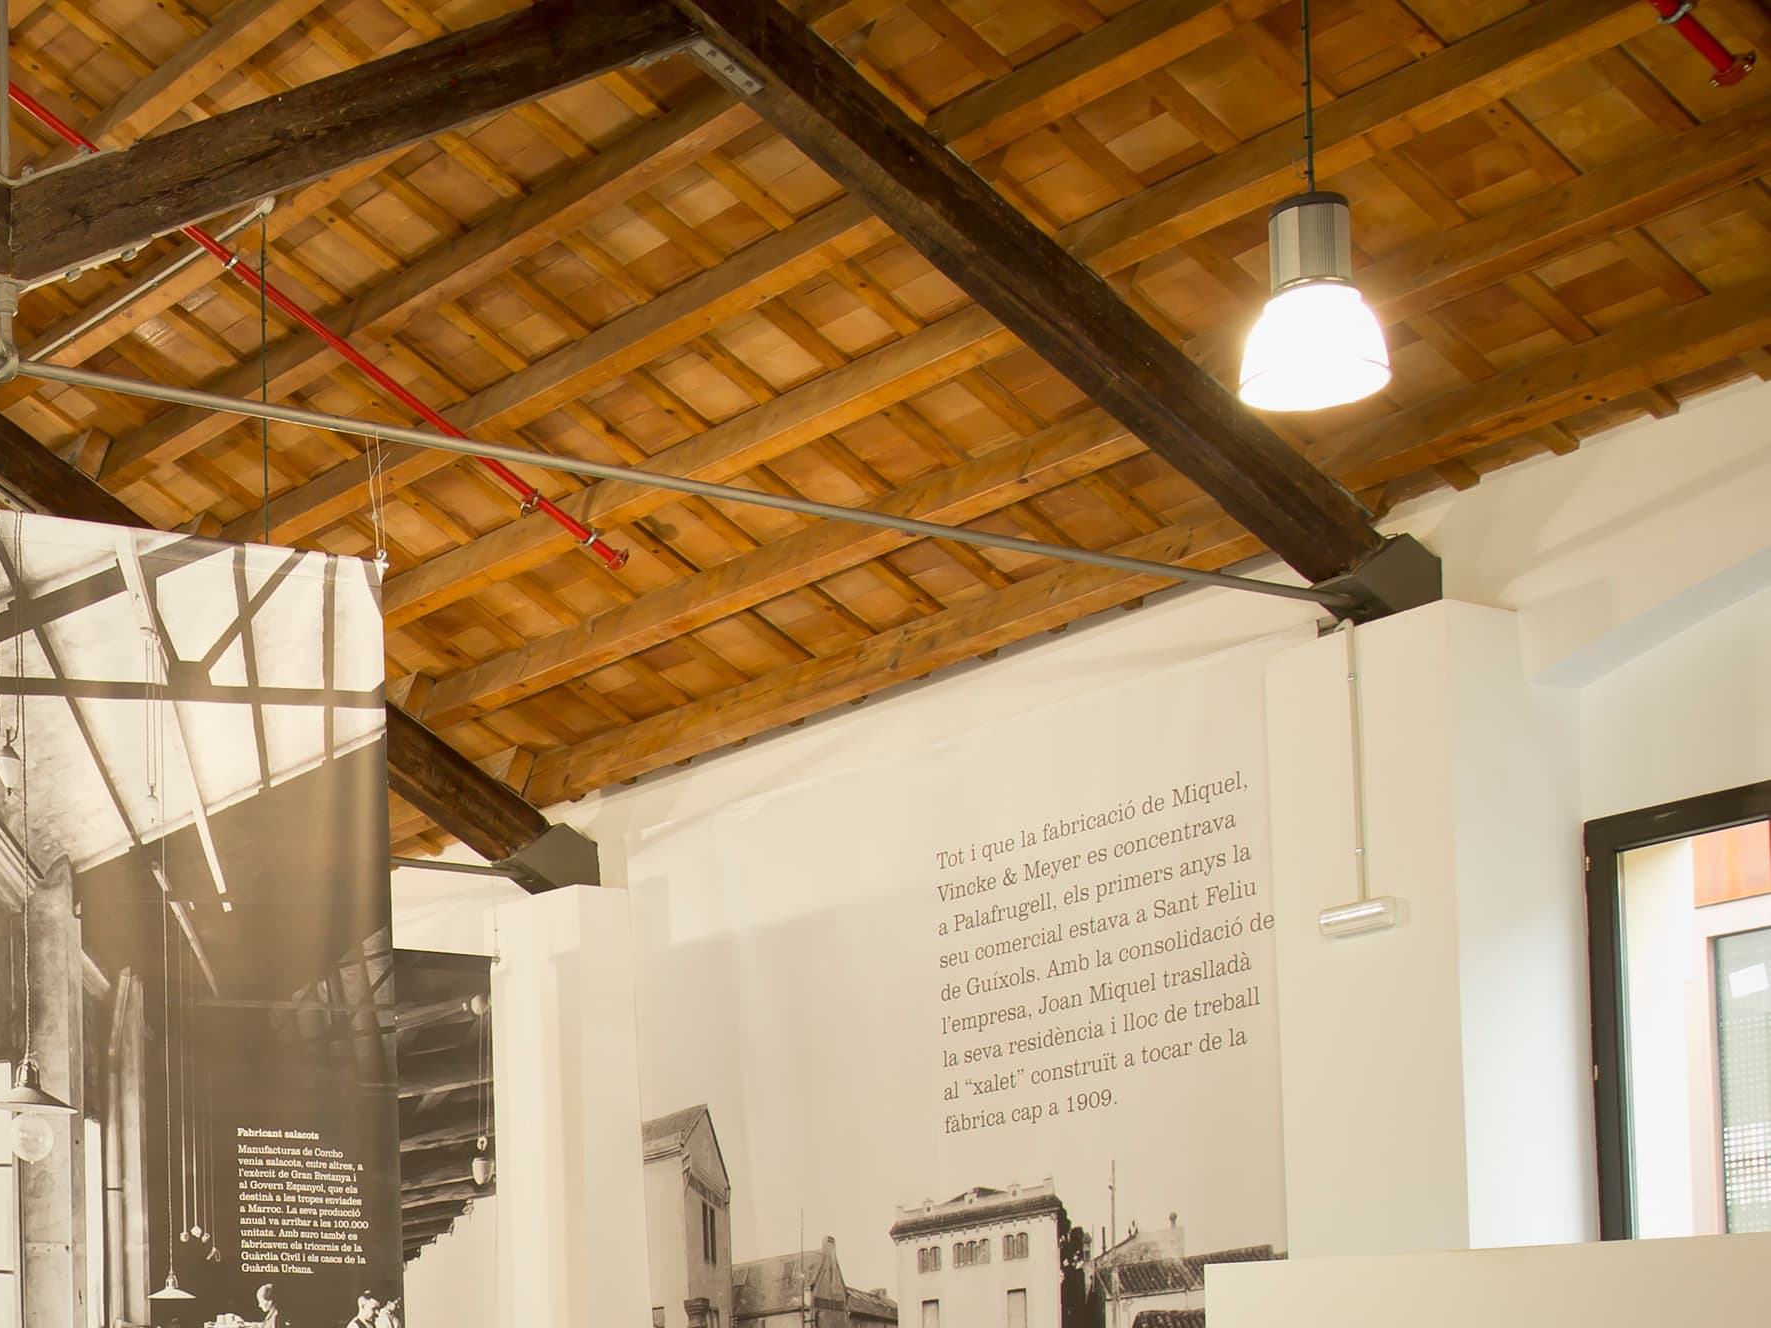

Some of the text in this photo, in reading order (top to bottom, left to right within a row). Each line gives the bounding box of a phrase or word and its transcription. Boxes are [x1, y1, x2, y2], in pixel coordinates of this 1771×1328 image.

[936, 771, 1248, 870] Tot i que la fabricació de Miquel,
[936, 814, 1236, 902] Vincke & Meyer es concentrava
[938, 844, 1252, 936] a Palafrugell, els primers anys la
[940, 880, 1257, 969] seu comercial estava a Sant Feliu
[941, 912, 1275, 1002] de Guíxols. Amb la consolidació de
[1038, 993, 1083, 1015] Joan
[1089, 972, 1156, 1004] Miquel
[1163, 951, 1252, 988] traslladà
[943, 986, 1260, 1068] la seva residència i lloc de treball
[944, 1081, 960, 1101] al
[1031, 1052, 1118, 1085] construït
[1124, 1053, 1136, 1068] a
[1141, 1041, 1193, 1064] tocar
[1199, 1033, 1222, 1053] de
[1228, 1028, 1248, 1047] la
[945, 1089, 1117, 1134] fàbrica cap a 1909.
